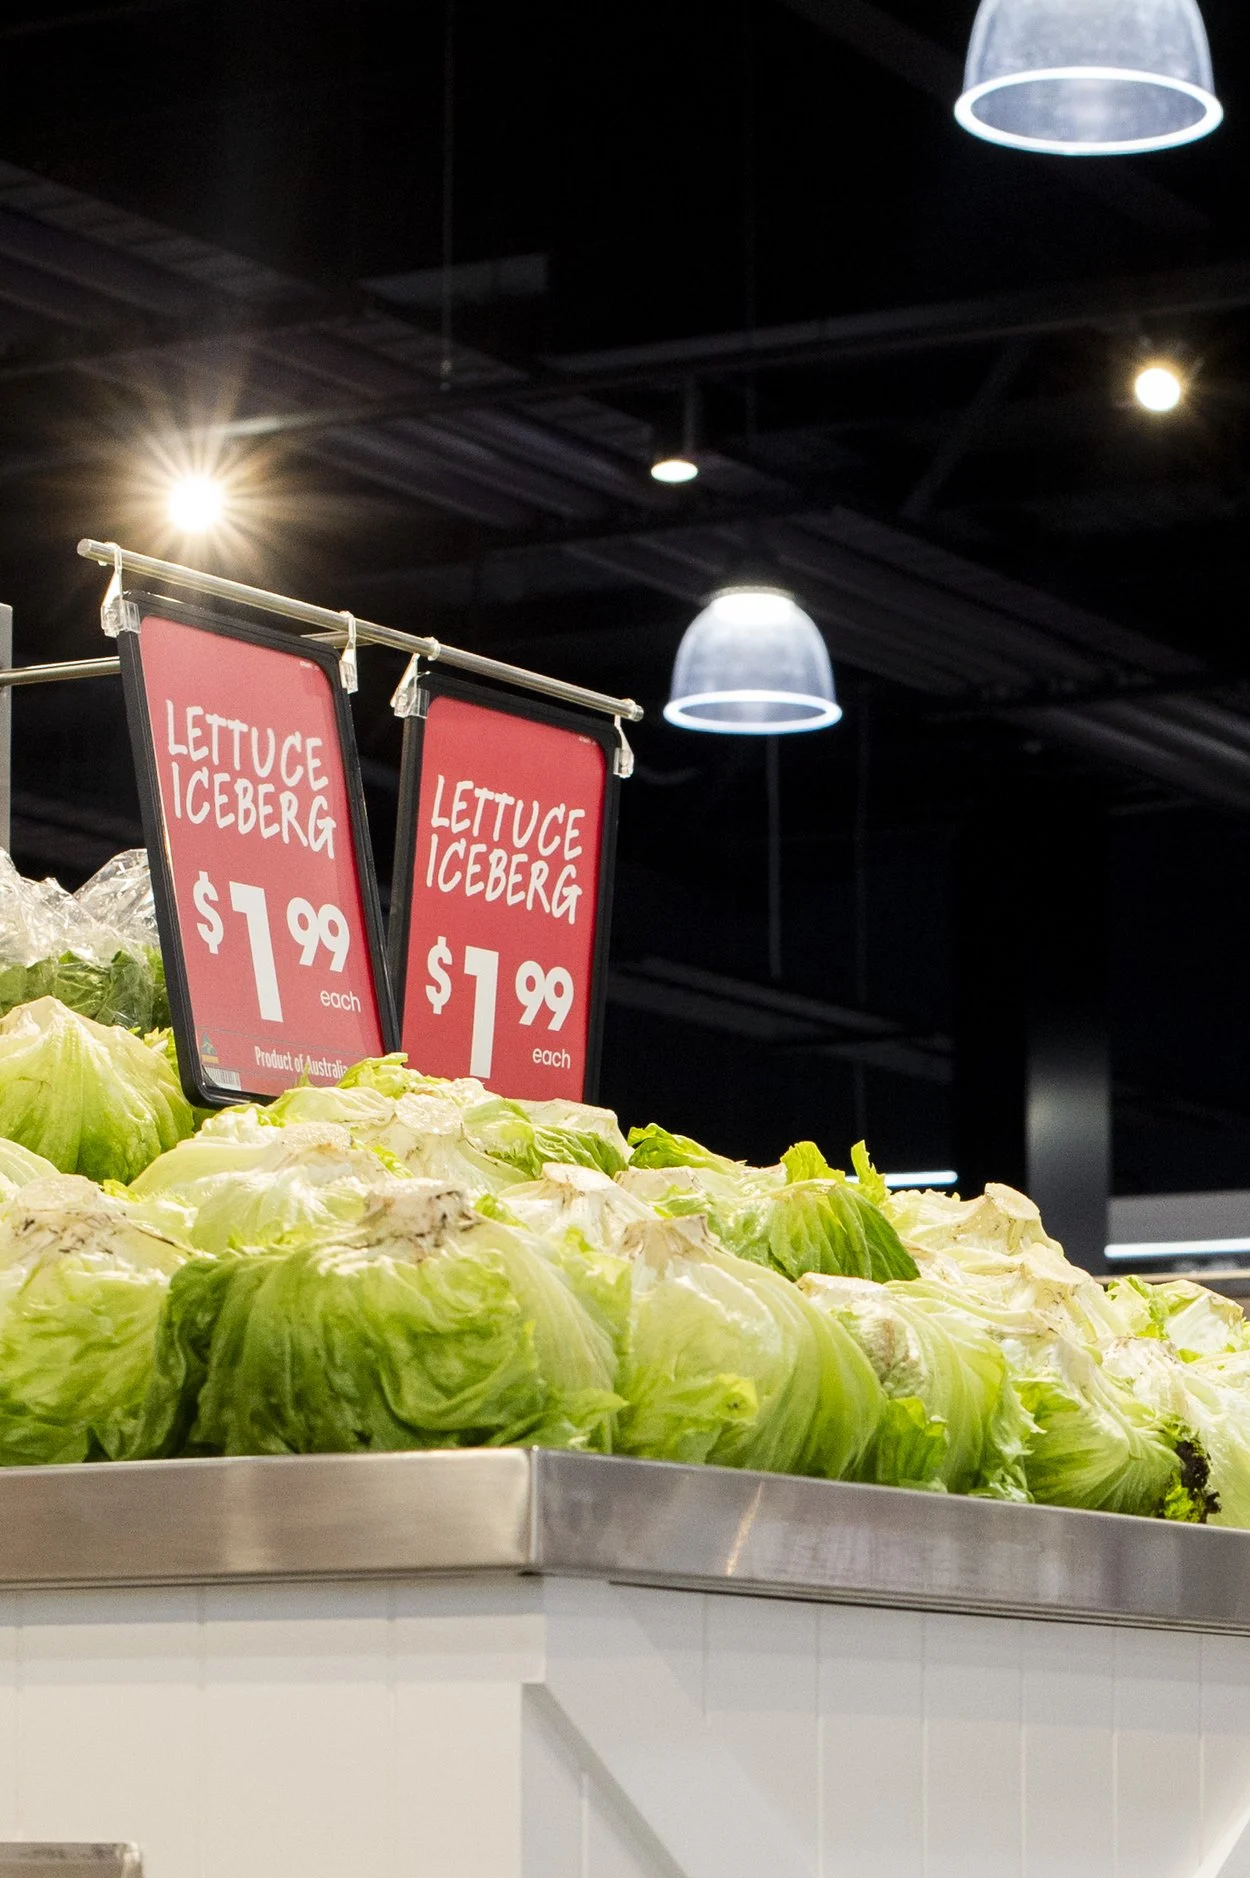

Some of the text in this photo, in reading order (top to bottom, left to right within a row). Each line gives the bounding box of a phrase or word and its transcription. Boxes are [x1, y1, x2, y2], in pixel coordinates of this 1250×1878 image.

[166, 699, 329, 791] LETTUCE
[171, 761, 337, 860] ICEBERG
[430, 774, 586, 860] LETTUCE
[426, 834, 583, 925] ICEBERG
[320, 988, 361, 1014] each
[255, 1045, 294, 1072] Product
[294, 1053, 304, 1073] of
[532, 1047, 572, 1070] each
